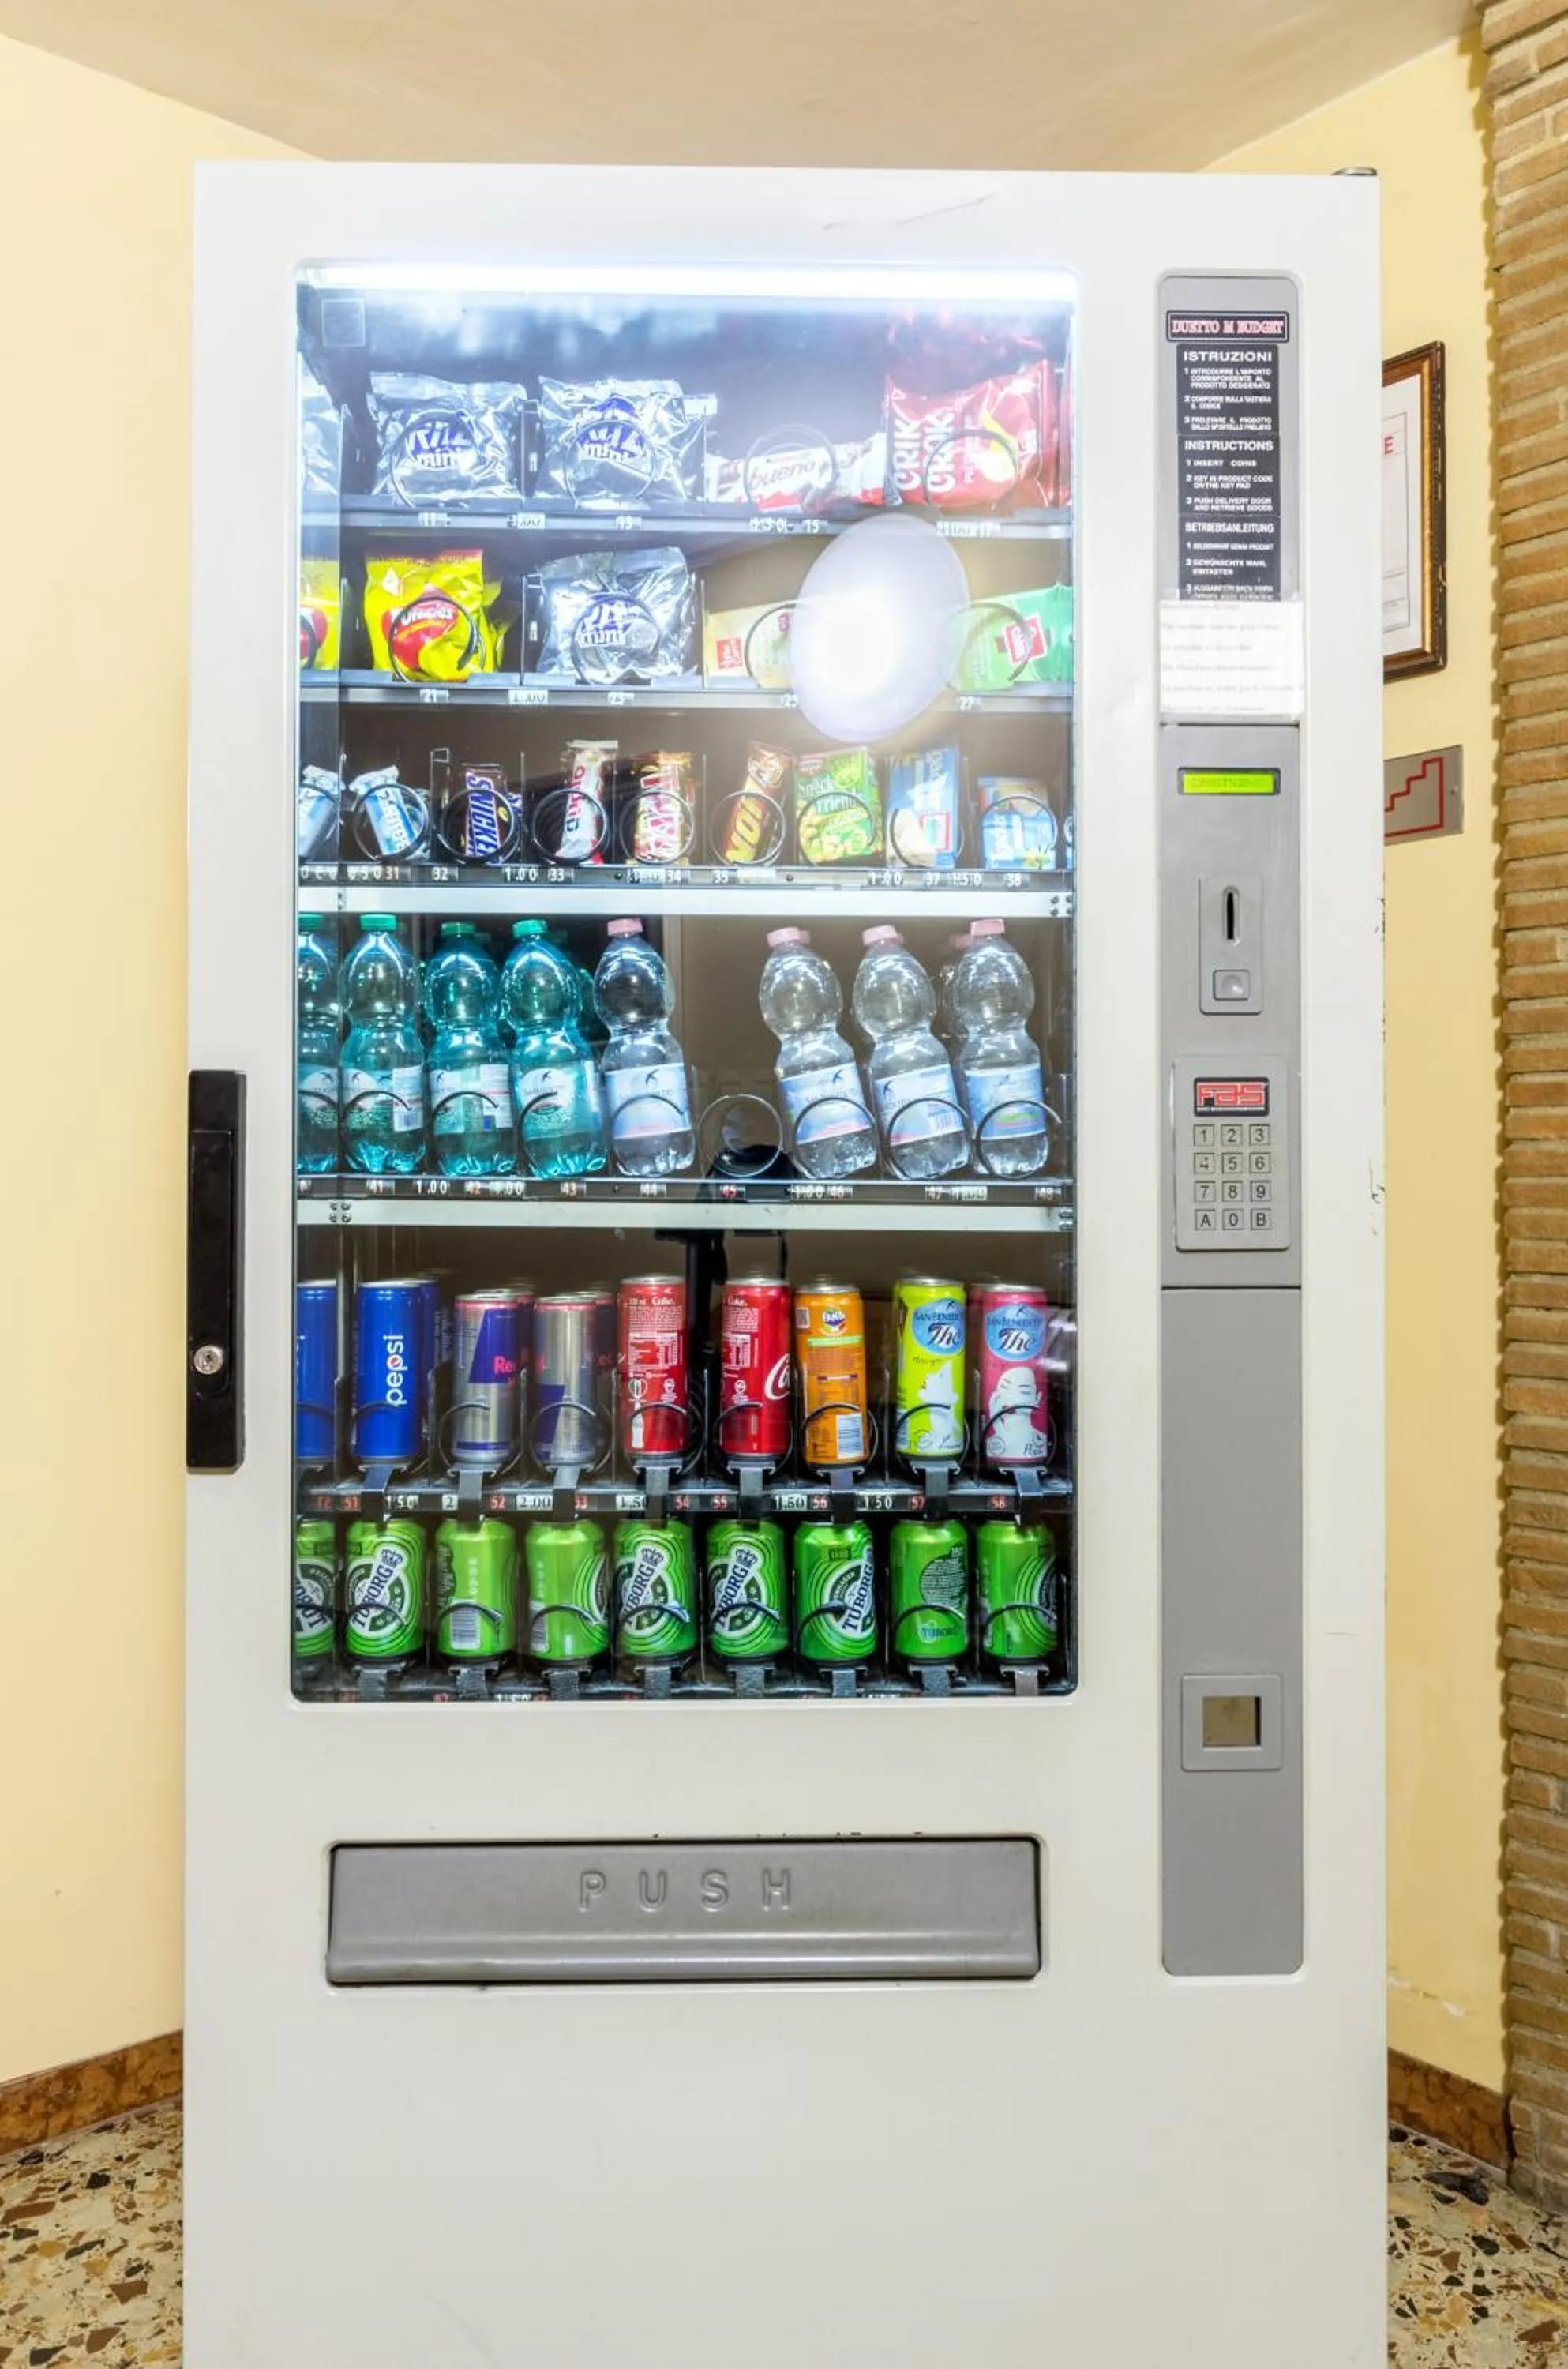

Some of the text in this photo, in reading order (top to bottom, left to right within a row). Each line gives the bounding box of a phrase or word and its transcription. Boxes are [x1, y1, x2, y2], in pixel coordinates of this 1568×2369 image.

[1184, 351, 1272, 362] ISTRUZIONI
[1185, 441, 1273, 451] INSTRUCTIONS
[892, 418, 922, 490] CRIK
[1185, 522, 1274, 532] BETRIEBSANLEITUNG
[1201, 1128, 1264, 1143] 1 2 3
[1199, 1156, 1265, 1170] 4 5 6
[1200, 1185, 1266, 1199] 7 8 9
[1200, 1213, 1212, 1226] A
[1256, 1212, 1266, 1226] B
[382, 1335, 408, 1405] pepsi
[577, 1868, 792, 1913] PUSH
